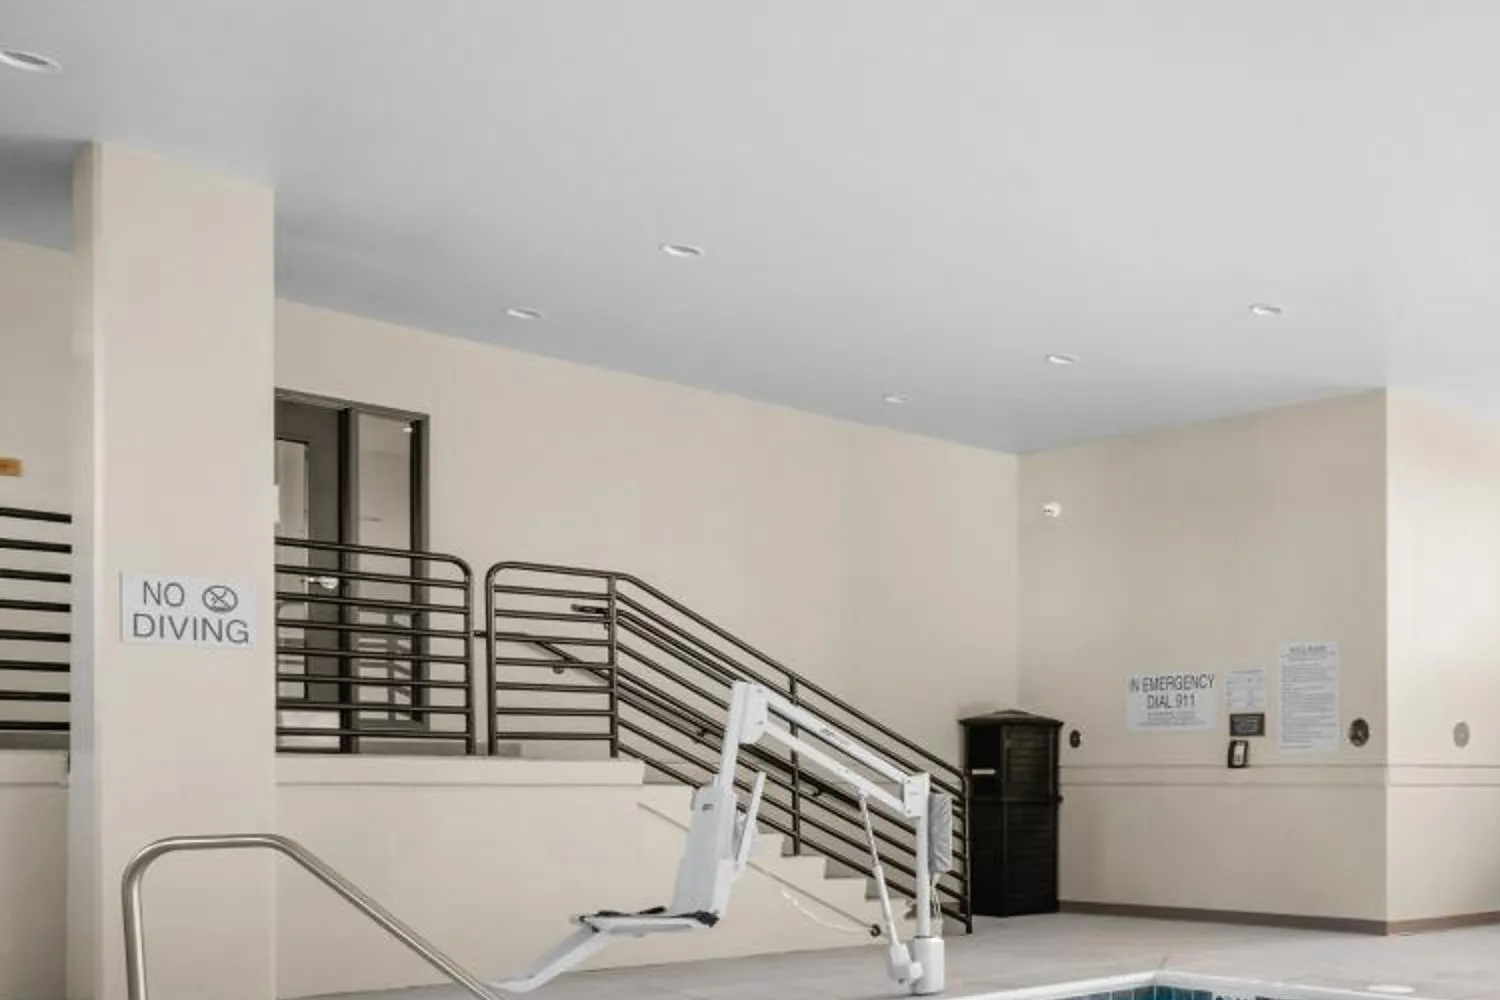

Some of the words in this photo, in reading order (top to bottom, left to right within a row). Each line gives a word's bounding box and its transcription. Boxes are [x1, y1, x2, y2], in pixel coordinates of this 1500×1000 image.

[143, 581, 185, 607] NO
[133, 613, 249, 644] DIVING
[1142, 673, 1215, 693] EMERGENCY
[1147, 694, 1173, 709] DIAL
[1175, 693, 1195, 707] 911
